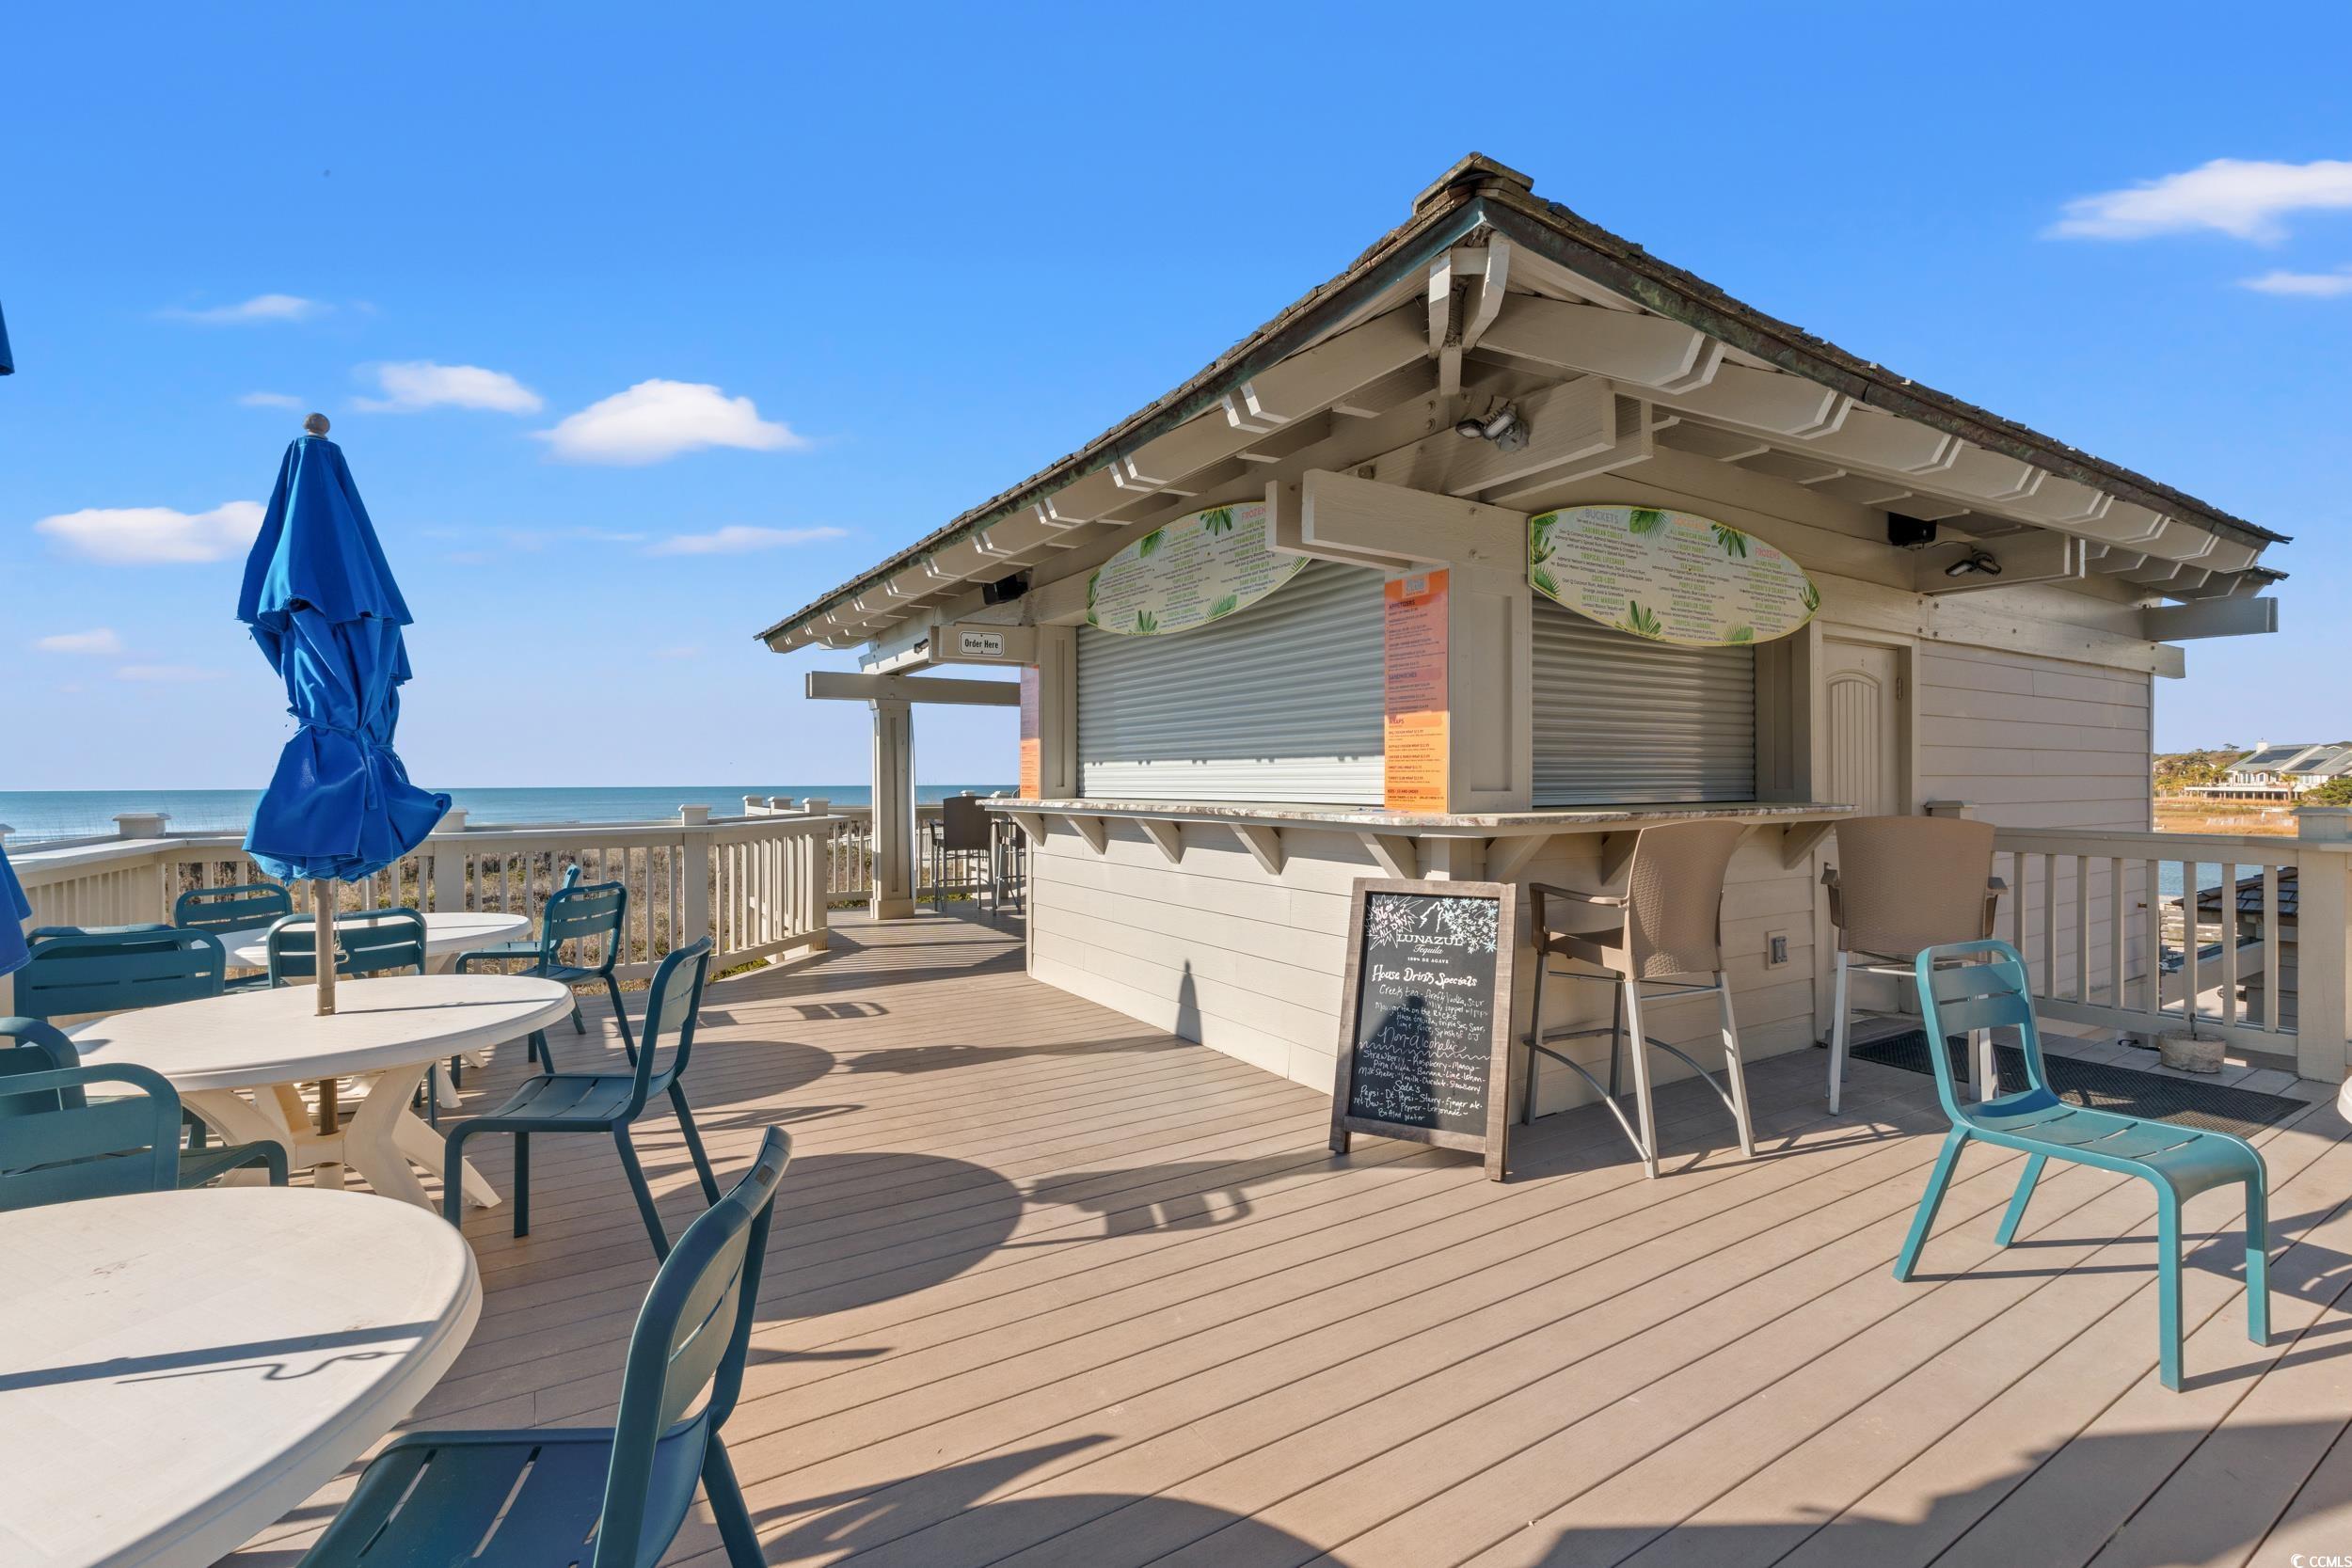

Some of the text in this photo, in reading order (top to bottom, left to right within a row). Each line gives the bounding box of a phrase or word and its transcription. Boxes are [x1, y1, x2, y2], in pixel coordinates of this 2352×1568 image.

[1585, 509, 1619, 524] BUCKETS
[964, 639, 998, 649] Order Here
[1391, 915, 1407, 930] DAY
[1397, 934, 1464, 946] LUNAZUL
[1413, 944, 1444, 957] Tequila
[1372, 964, 1478, 989] House Drink Specials
[1393, 1080, 1421, 1093] Soda's
